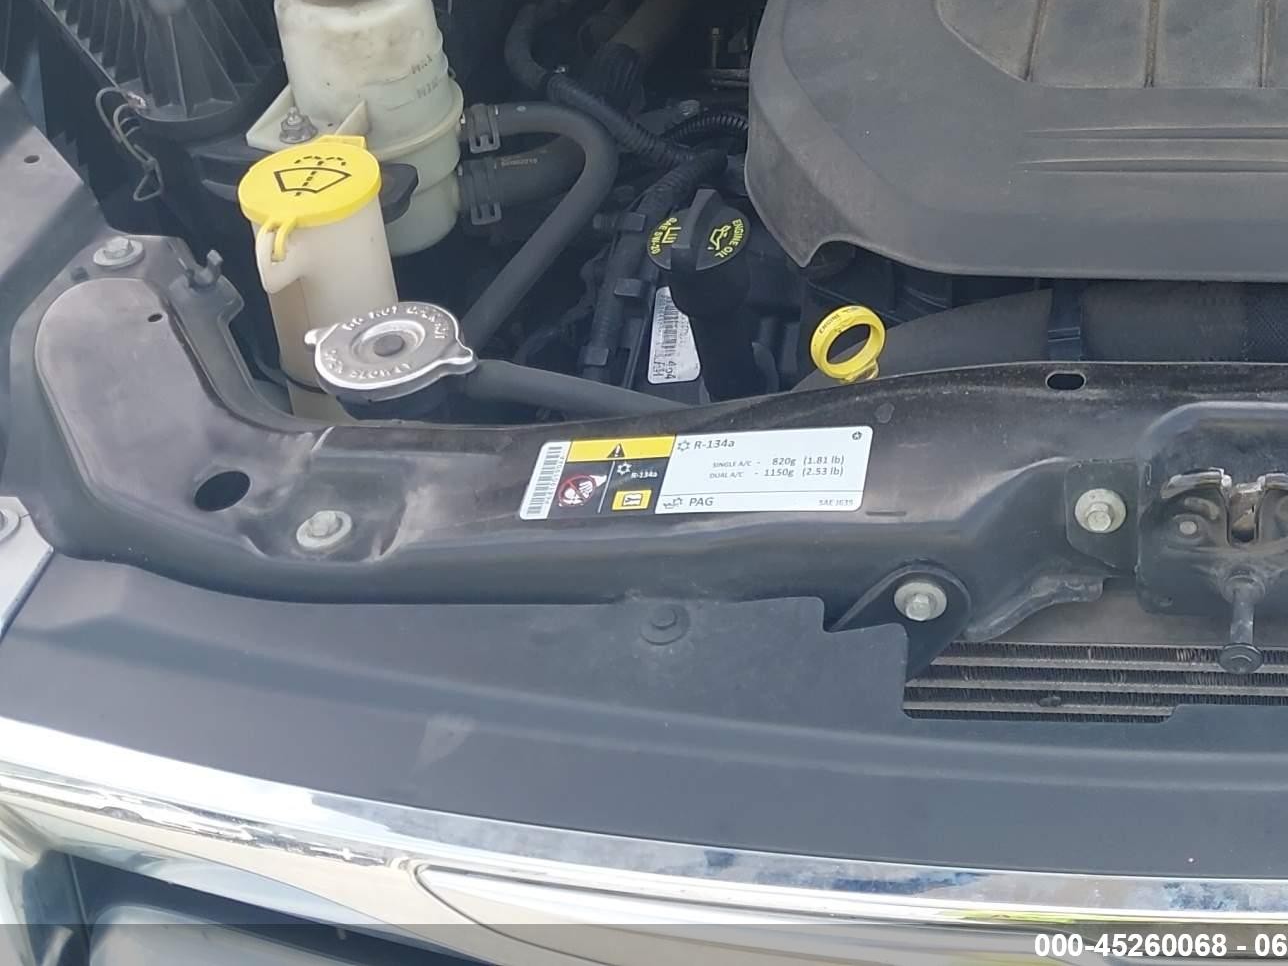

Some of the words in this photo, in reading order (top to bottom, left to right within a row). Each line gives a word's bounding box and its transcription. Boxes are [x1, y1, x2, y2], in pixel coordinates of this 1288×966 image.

[658, 217, 678, 231] SAE
[732, 218, 744, 247] ENGINE
[650, 231, 664, 255] 5W-20
[714, 246, 734, 258] OIL
[819, 313, 841, 334] ENGINE
[693, 438, 736, 450] R-134a
[772, 457, 797, 467] 820g
[803, 455, 828, 465] (1.81
[831, 454, 845, 465] lb)
[631, 470, 658, 479] R-134a
[764, 468, 794, 478] 1150g
[802, 466, 828, 477] (2.53
[830, 466, 844, 477] lb)
[689, 497, 715, 507] PAG
